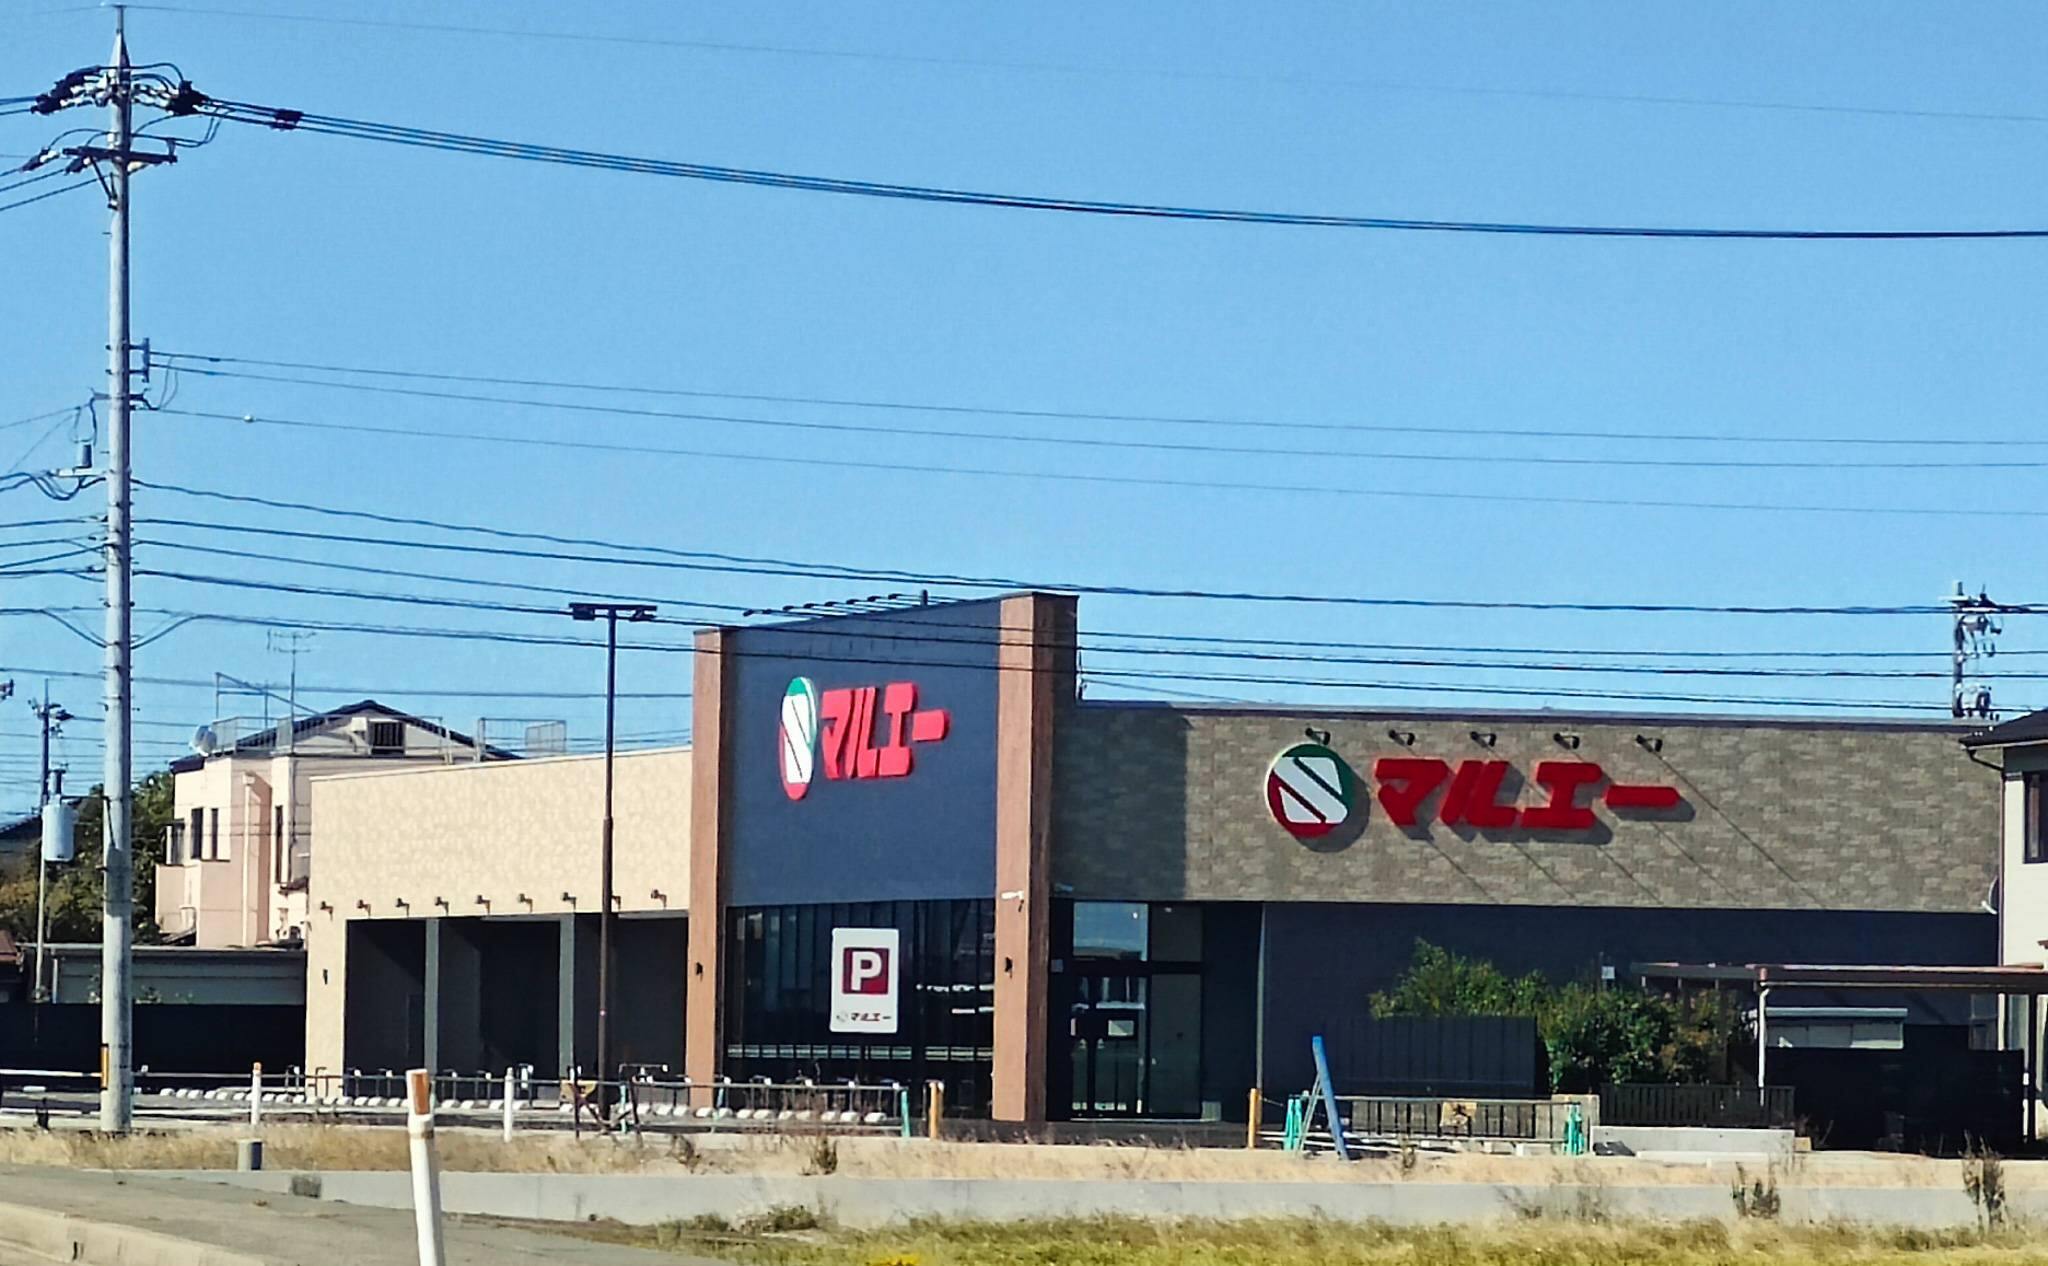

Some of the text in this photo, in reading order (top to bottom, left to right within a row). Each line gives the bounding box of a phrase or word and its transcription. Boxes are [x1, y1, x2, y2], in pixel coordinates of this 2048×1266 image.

[821, 682, 947, 780] マルエー
[1375, 757, 1682, 830] マルエー
[850, 950, 882, 992] P
